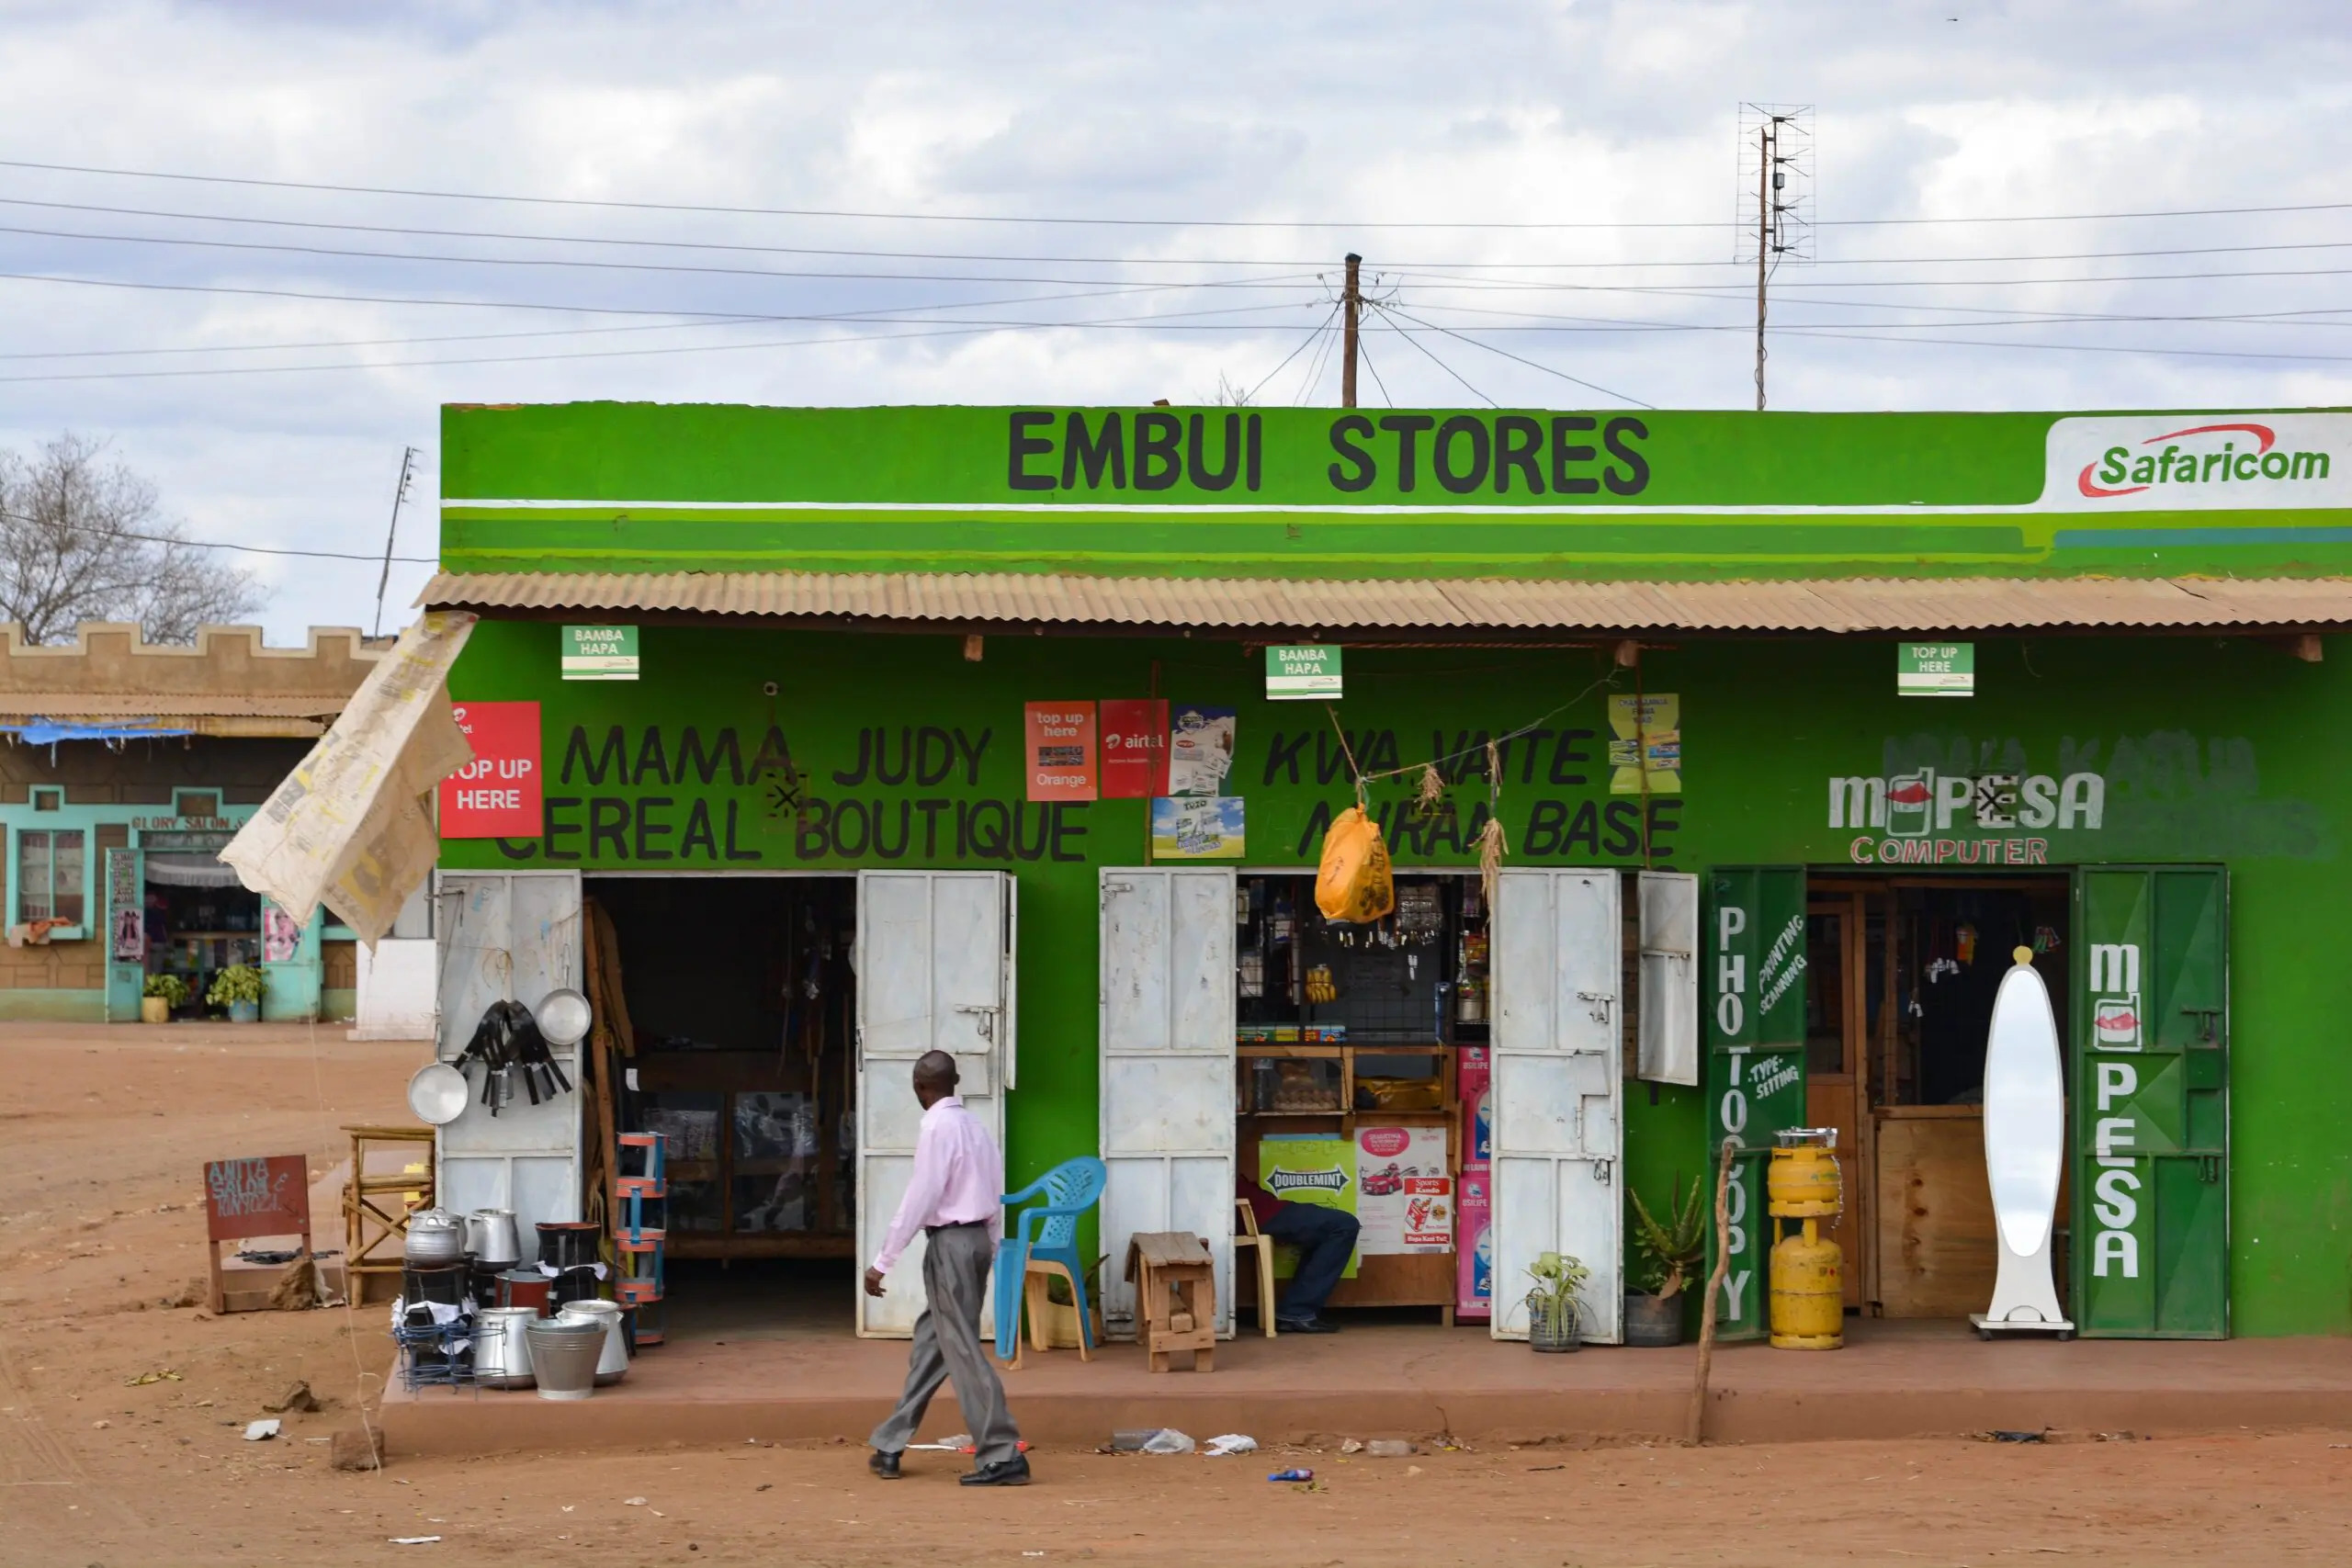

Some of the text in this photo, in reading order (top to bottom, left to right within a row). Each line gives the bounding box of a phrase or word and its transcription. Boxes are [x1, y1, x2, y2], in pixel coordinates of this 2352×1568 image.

[1008, 411, 1652, 496] EMBUI STORES
[2098, 442, 2331, 485] Safaricom
[574, 629, 625, 641] BAMBA
[581, 642, 619, 655] HAPA
[1279, 649, 1328, 661] BAMBA
[1912, 646, 1959, 659] TOP UP
[1284, 662, 1322, 674] HAPA
[1919, 660, 1952, 673] HERE
[1036, 712, 1083, 725] top up
[1044, 724, 1078, 737] here
[1125, 734, 1164, 750] airtel
[560, 724, 993, 787] MAMA JUDY
[1262, 728, 1402, 786] KWA
[448, 759, 533, 780] OP UP
[1035, 773, 1087, 788] Orange
[457, 789, 521, 809] HERE
[132, 816, 178, 829] GLORY
[185, 816, 230, 829] SALON
[795, 797, 1091, 863] BOUTIQUE
[1522, 798, 1685, 857] BASE
[1849, 836, 2049, 864] COMPUTER
[1758, 914, 1804, 994] PRINTING
[1758, 953, 1808, 1015] SCANNING
[1756, 1065, 1800, 1100] SETTING
[1273, 1172, 1341, 1188] DOUBLEMINT
